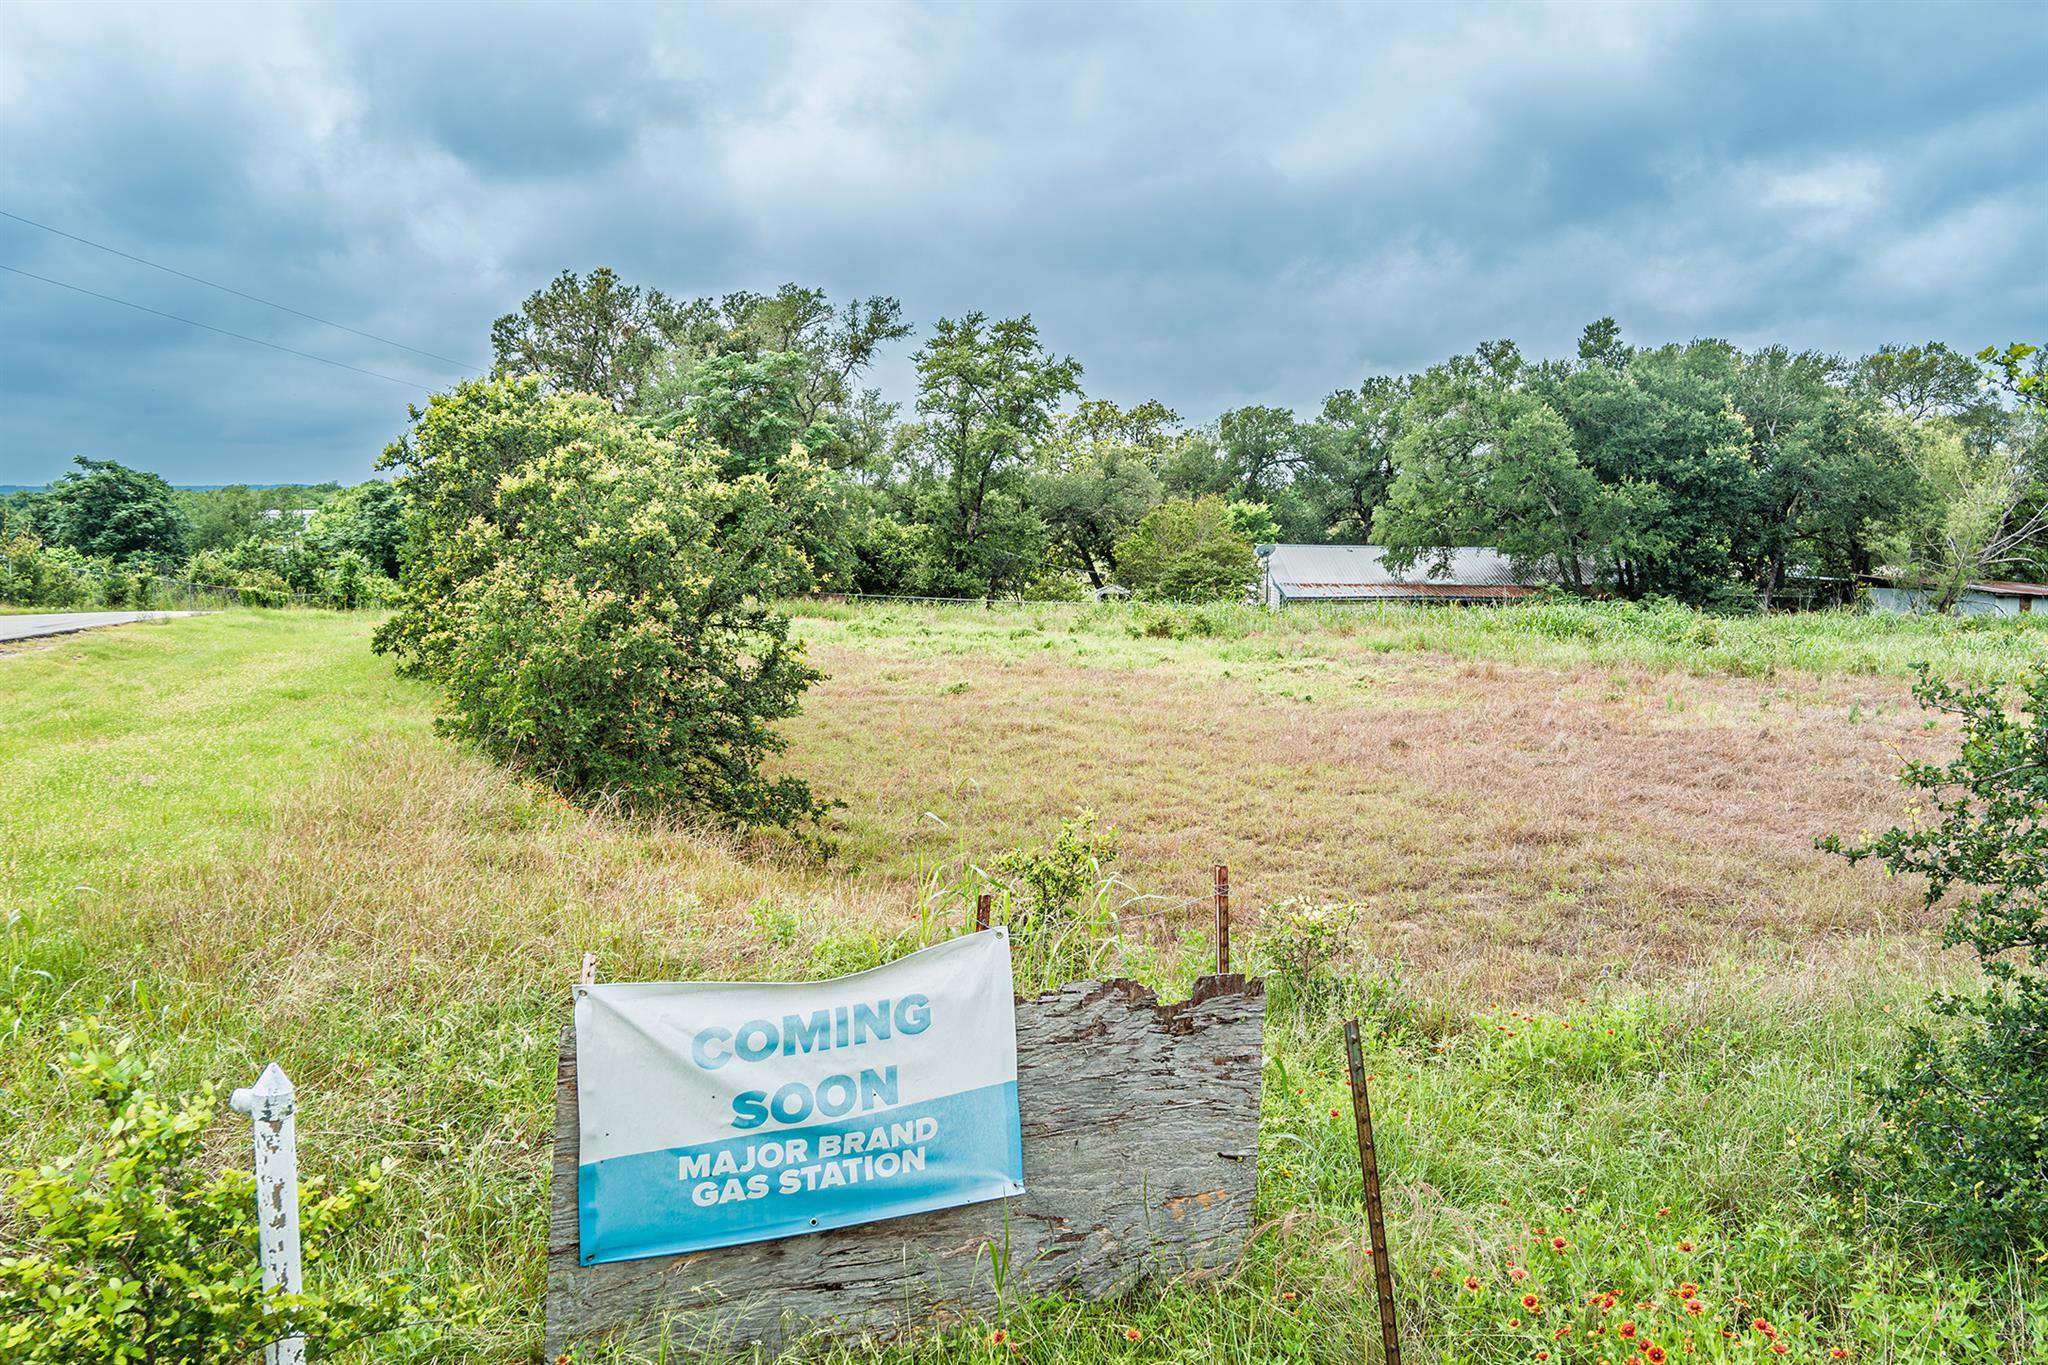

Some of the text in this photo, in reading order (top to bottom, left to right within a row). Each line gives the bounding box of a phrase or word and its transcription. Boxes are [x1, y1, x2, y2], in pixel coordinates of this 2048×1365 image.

[691, 993, 932, 1070] COMING
[730, 1064, 899, 1129] SOON
[678, 1117, 938, 1180] MAJOR BRAND
[691, 1146, 926, 1207] GAS STATION
